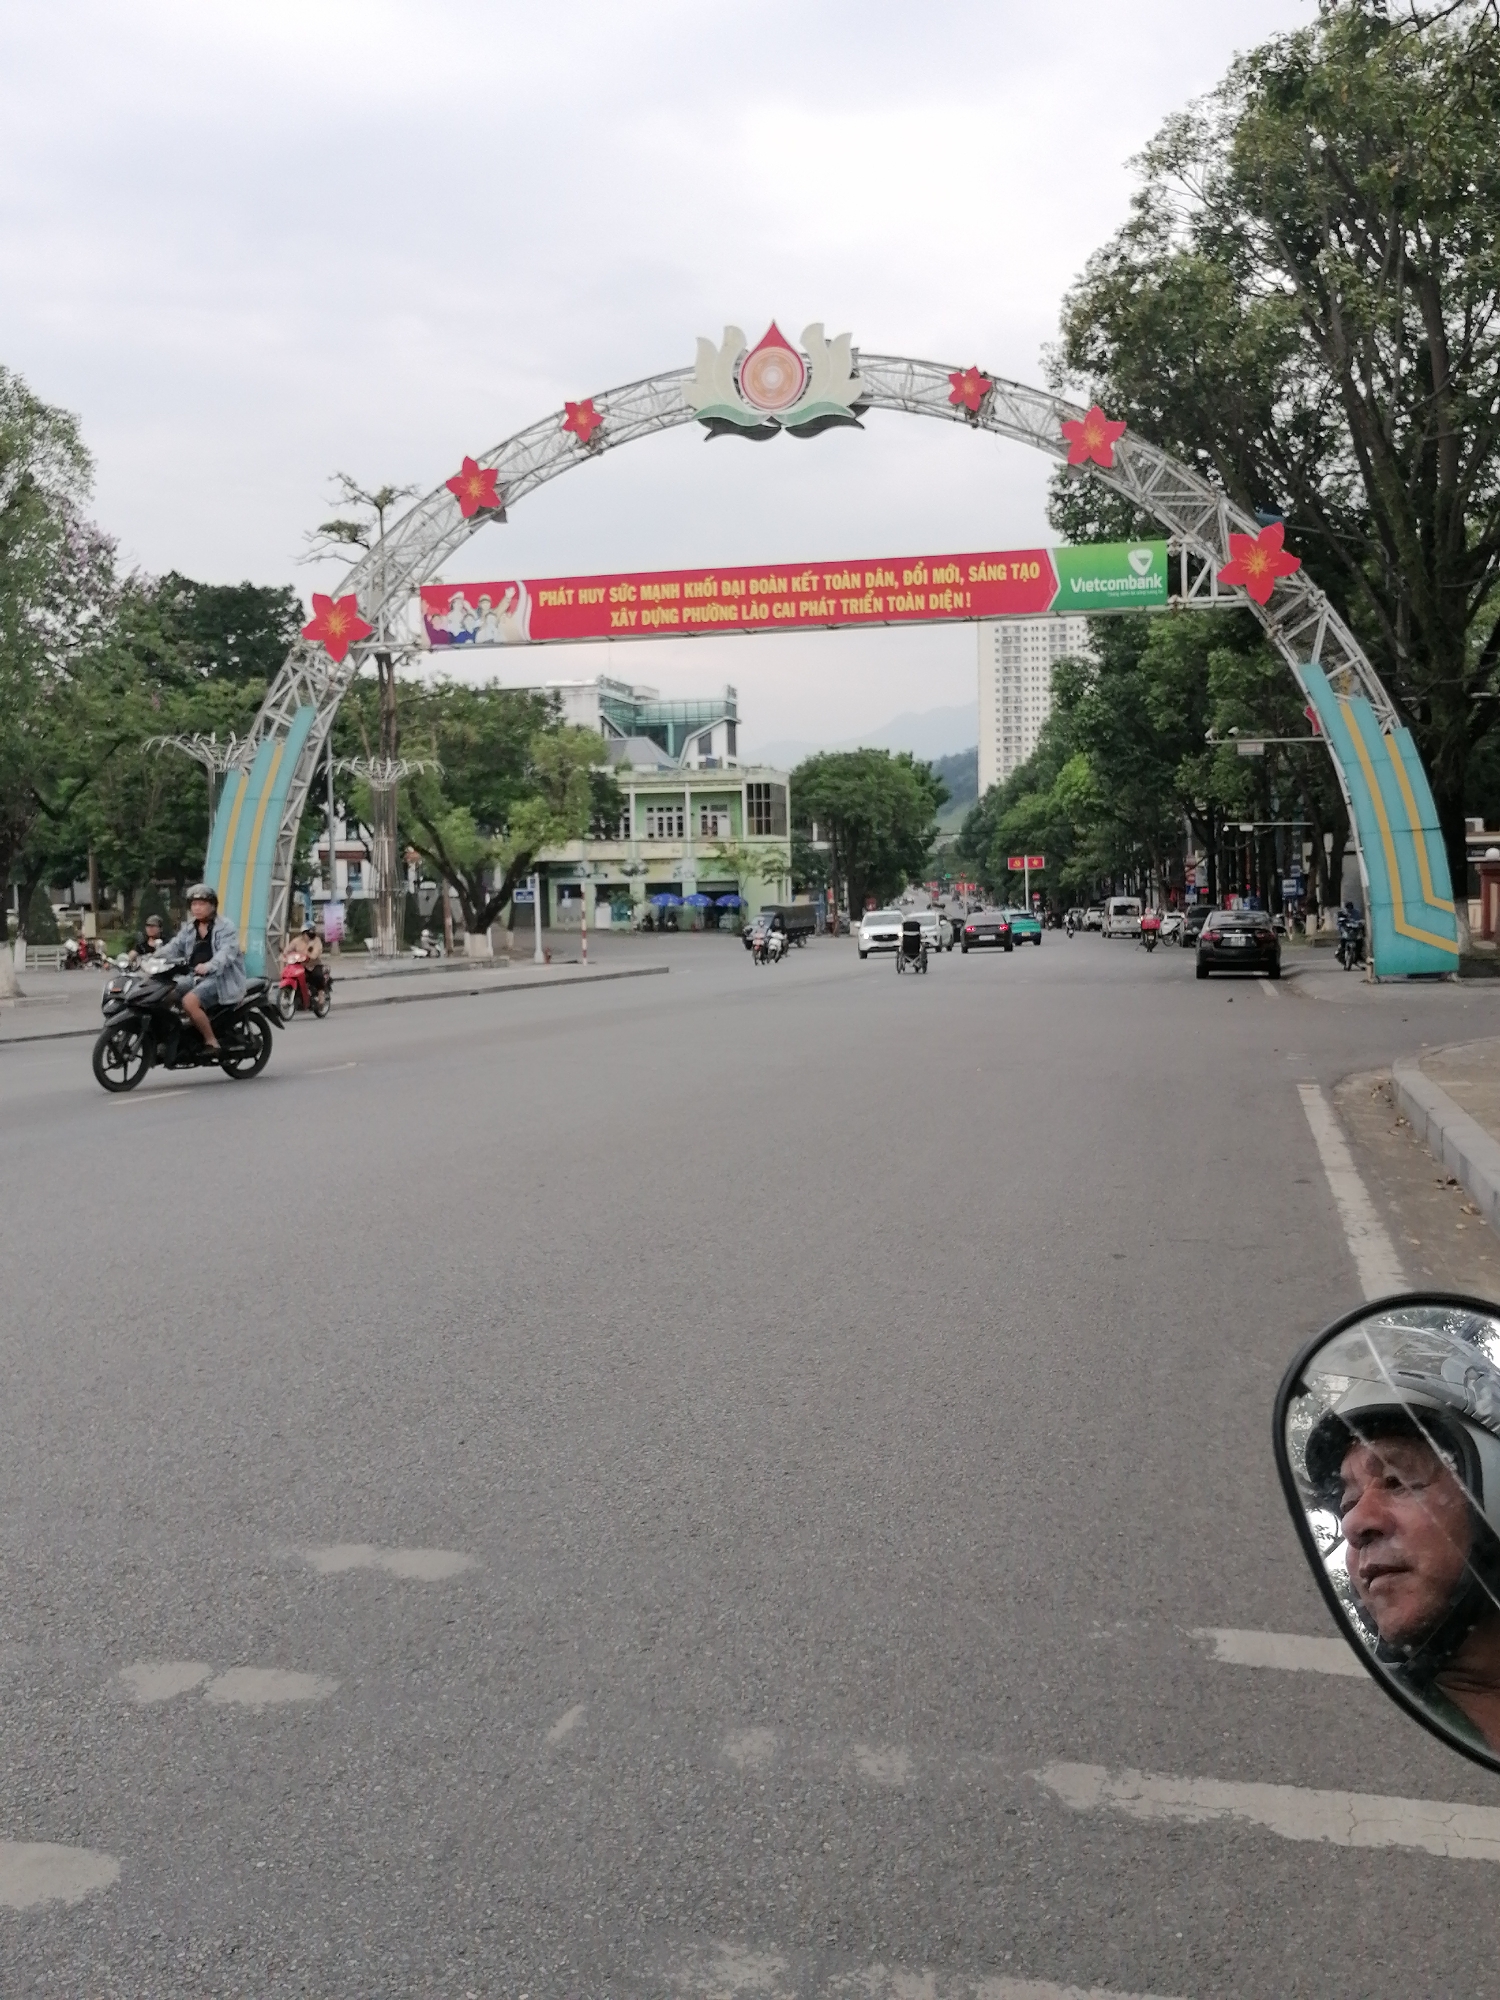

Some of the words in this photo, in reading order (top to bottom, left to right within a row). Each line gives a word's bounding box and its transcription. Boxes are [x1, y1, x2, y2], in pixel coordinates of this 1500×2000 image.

[539, 586, 574, 606] PHÁT
[578, 588, 606, 604] HUY
[609, 583, 637, 603] SỨC
[640, 583, 680, 603] MẠNH
[684, 575, 718, 598] KHỐI
[721, 580, 745, 599] ĐẠI
[749, 574, 788, 595] ĐOÀN
[792, 570, 820, 593] KẾT
[823, 570, 862, 590] TOÀN
[865, 567, 899, 589] DÂN,
[903, 561, 928, 586] ĐỔI
[932, 563, 964, 586] MỚI,
[968, 561, 1007, 583] SÁNG
[1010, 562, 1040, 582] TẠO
[1070, 572, 1162, 594] Vietcombank
[611, 607, 638, 628] XÂY
[641, 606, 678, 628] DỰNG
[682, 602, 738, 624] PHƯỜNG
[742, 600, 769, 620] LÀO
[772, 602, 796, 618] CAI
[800, 596, 836, 618] PHÁT
[840, 589, 883, 614] TRIỂN
[887, 592, 925, 612] TOÀN
